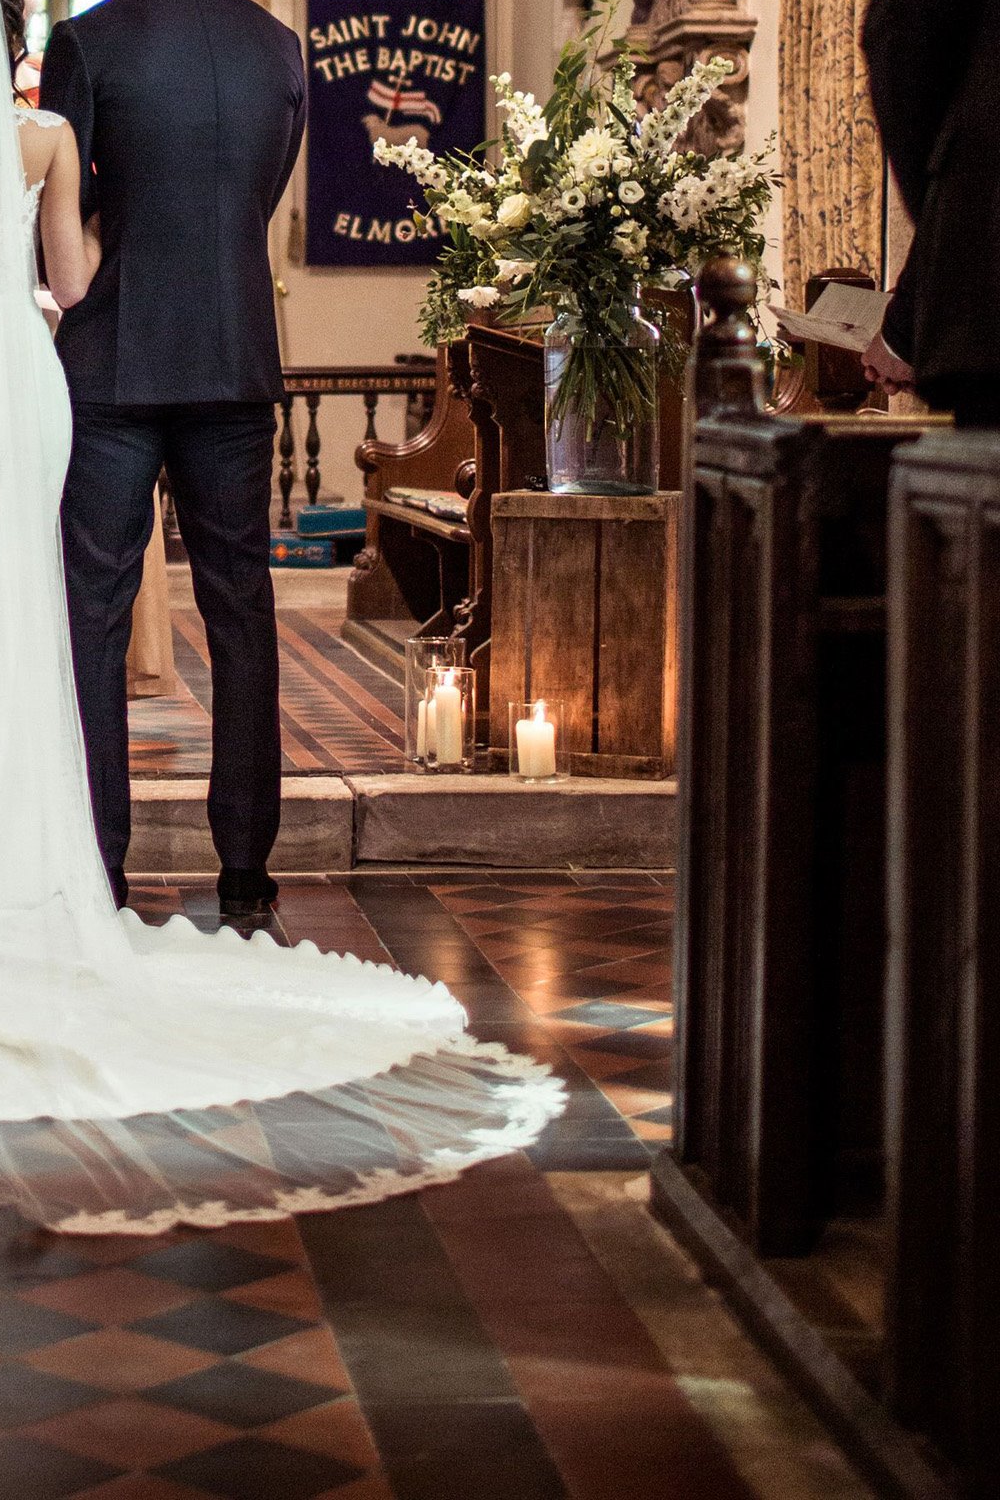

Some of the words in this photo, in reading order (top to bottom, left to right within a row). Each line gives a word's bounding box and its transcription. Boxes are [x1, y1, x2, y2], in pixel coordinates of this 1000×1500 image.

[310, 14, 390, 49] SAINT
[402, 14, 480, 54] JOHN
[314, 49, 371, 82] THE
[377, 46, 475, 85] BAPTIST
[303, 378, 333, 388] WERE
[338, 378, 391, 388] ERECTED
[394, 378, 408, 388] BY
